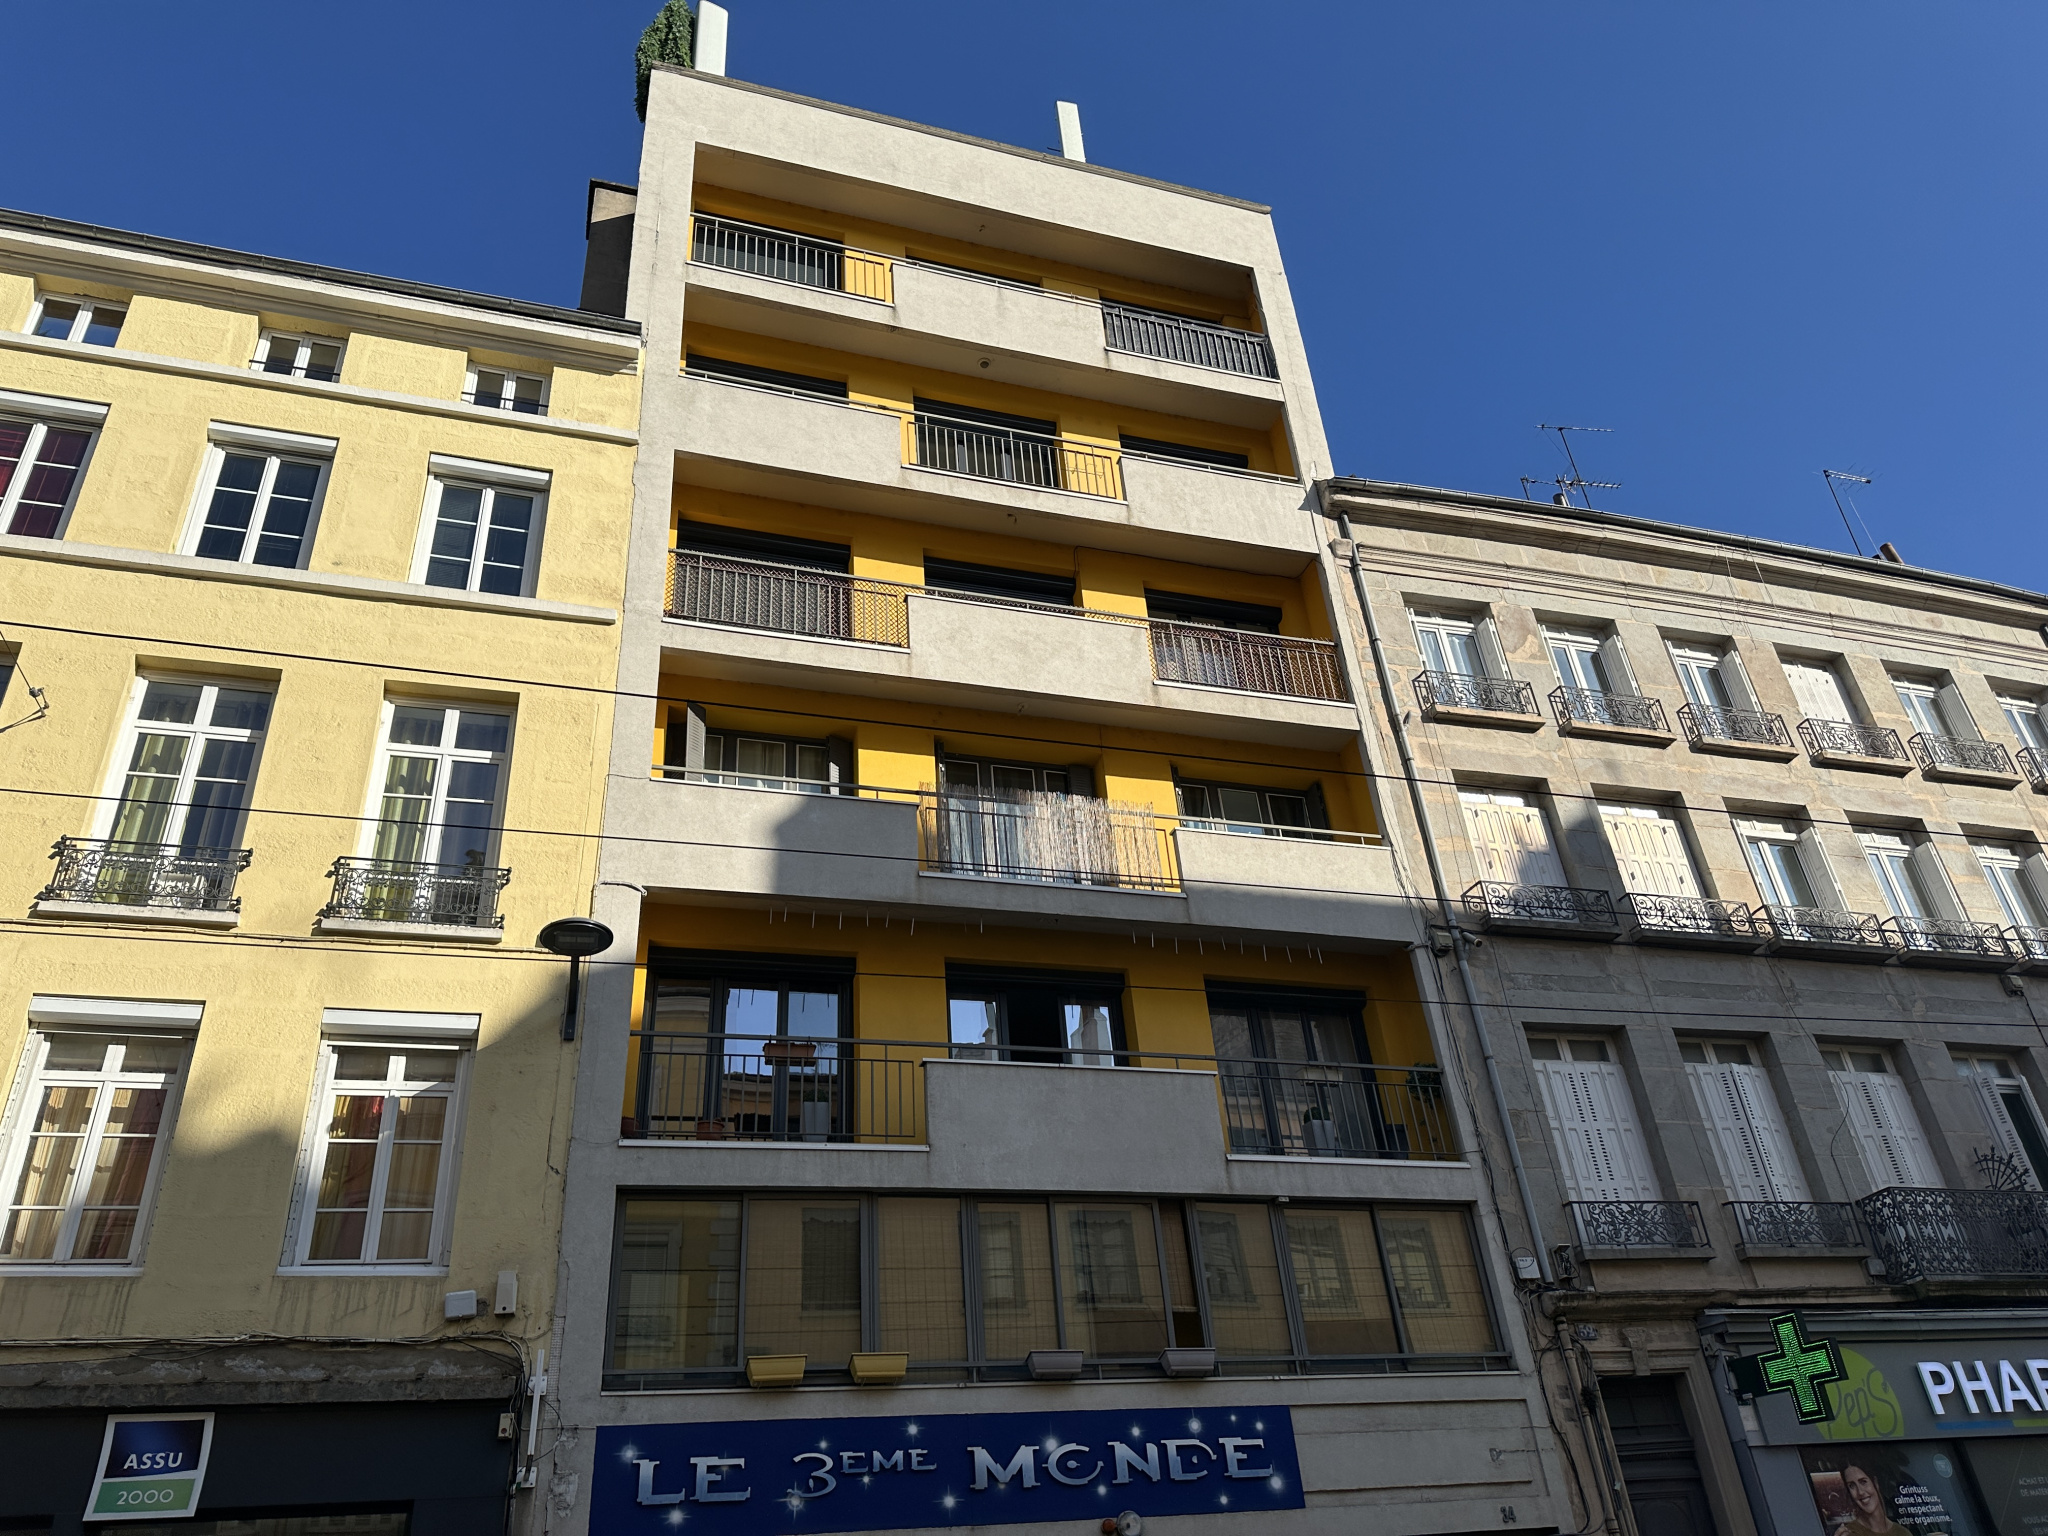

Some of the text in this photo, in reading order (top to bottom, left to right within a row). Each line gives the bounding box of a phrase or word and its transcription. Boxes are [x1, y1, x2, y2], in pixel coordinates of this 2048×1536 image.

[123, 1452, 183, 1470] ASSU
[632, 1456, 751, 1506] LE
[967, 1437, 1274, 1490] MONDE
[1899, 1485, 1929, 1494] Grintuss
[116, 1489, 174, 1505] 2000
[1894, 1494, 1941, 1504] calme la toux,
[1907, 1504, 1944, 1515] respectant
[1896, 1514, 1953, 1526] votre organisme.
